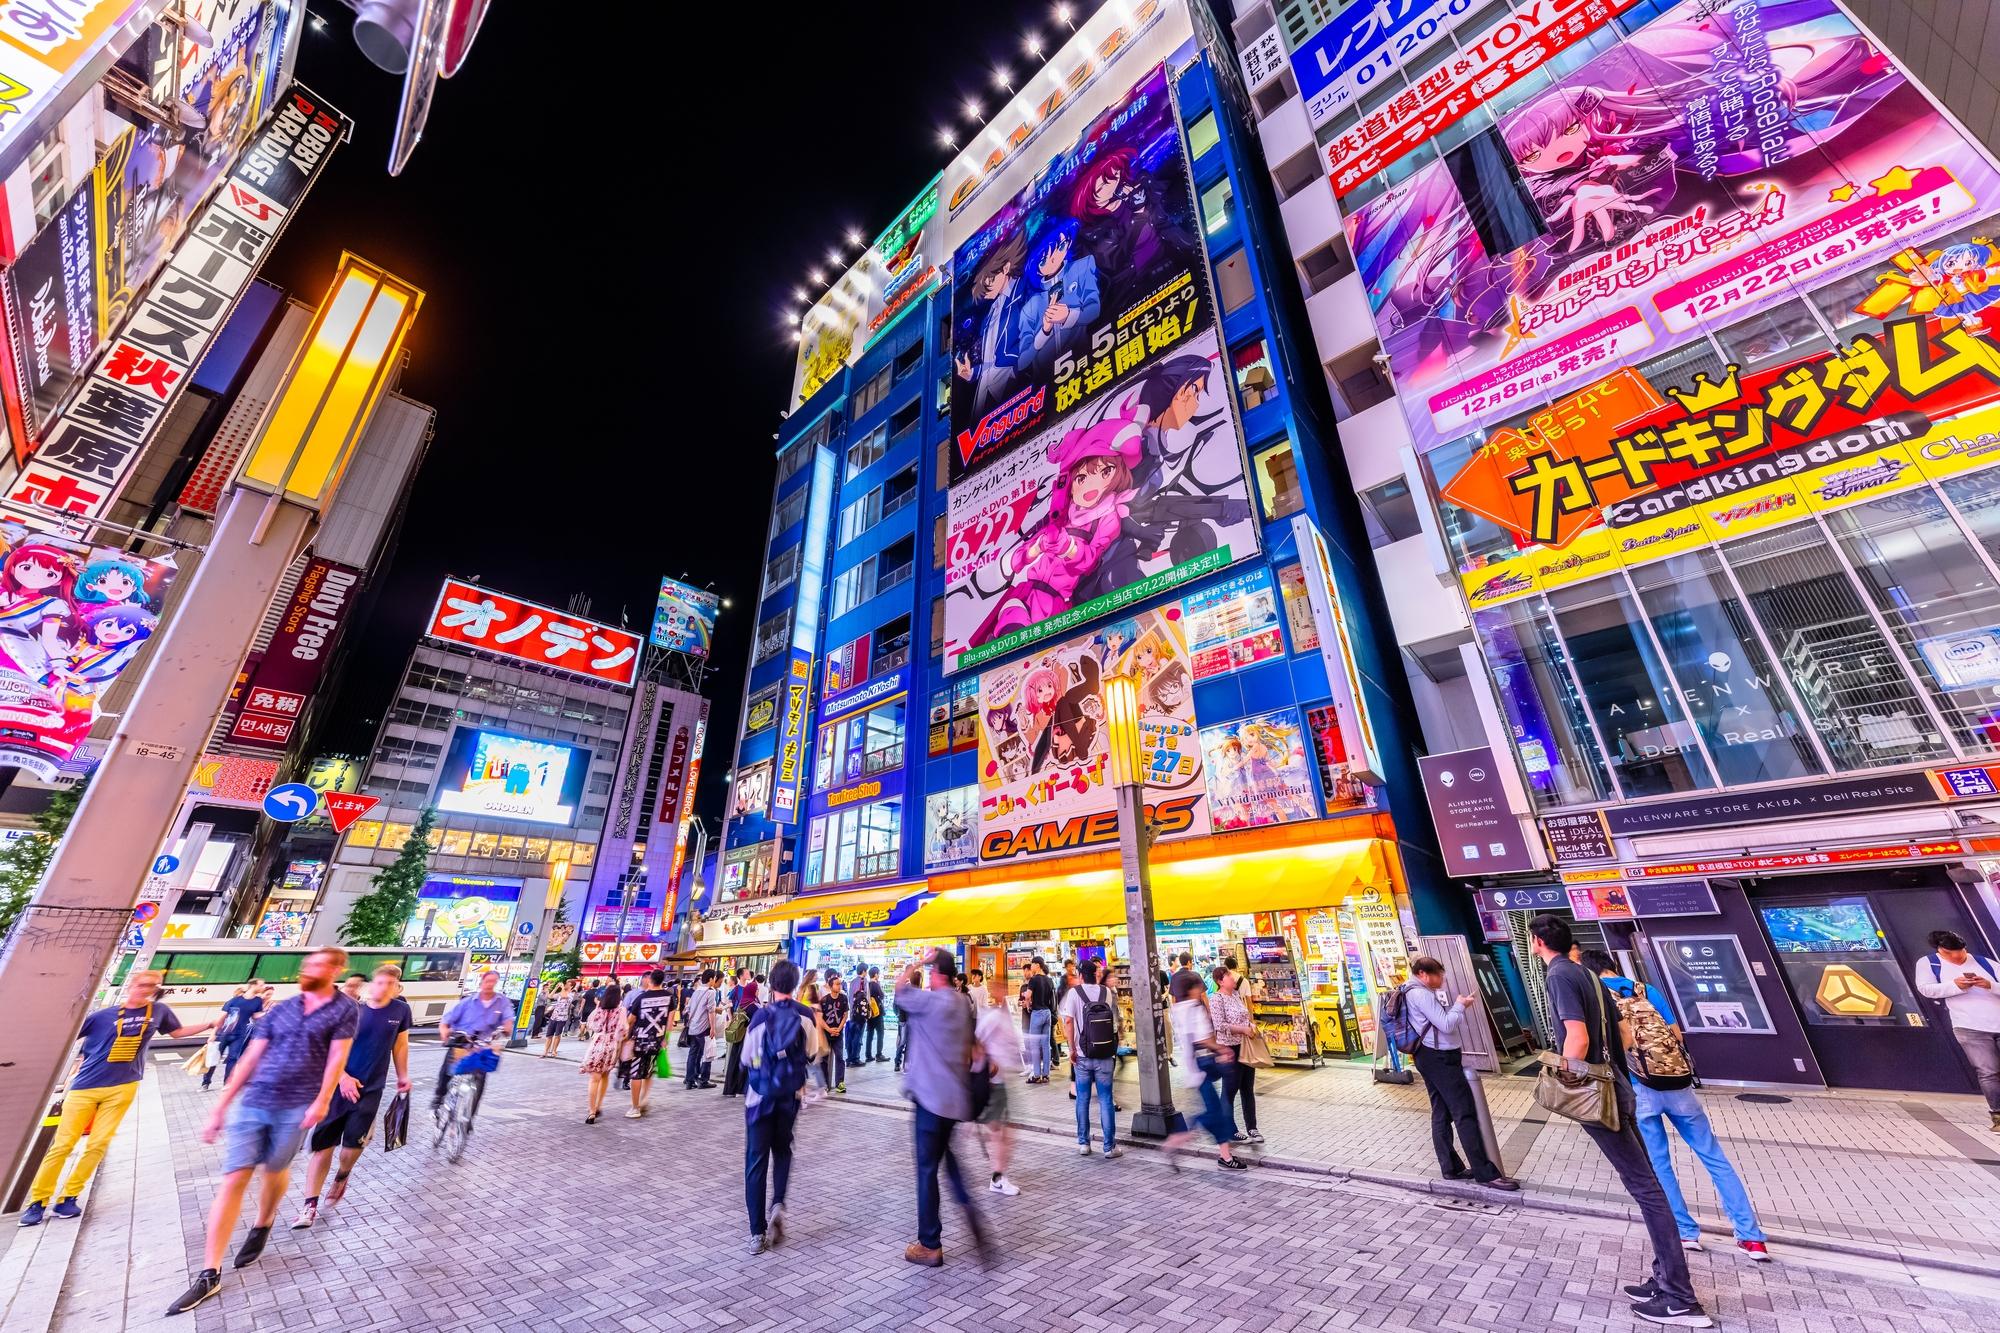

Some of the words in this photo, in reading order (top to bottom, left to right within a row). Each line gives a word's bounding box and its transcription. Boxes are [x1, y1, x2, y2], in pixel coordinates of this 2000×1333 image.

[1244, 47, 1265, 86] 野村ビル
[1260, 33, 1283, 73] 秋葉原
[1711, 41, 1750, 142] すべてを賭ける
[238, 90, 317, 187] PARADISE
[291, 108, 339, 177] HOBBY
[1338, 91, 1467, 189] ホビーランド
[1558, 256, 1612, 291] BanG
[1615, 204, 1707, 272] Dream!
[1683, 195, 1941, 320] 12月22日(金)発売!
[867, 264, 936, 330] TAKARADA
[1053, 284, 1196, 384] 5月5日(土)より
[11, 212, 265, 516] ボークス秋葉原ホ
[1054, 297, 1199, 413] 放送開始!
[1461, 337, 1618, 417] 12月8日(金)発売!
[1478, 380, 1619, 459] カードゲームで
[1513, 318, 2000, 542] カードキングダム
[1920, 431, 2000, 461] Cha
[952, 435, 1065, 508] ガンゲイル・オンライン
[1613, 420, 1912, 523] cardkingdom
[1010, 478, 1038, 502] 第1巻
[1822, 472, 1901, 501] Schwarz
[1620, 534, 1660, 552] Battle
[1661, 523, 1700, 540] Spirits
[970, 551, 997, 572] SALE
[297, 564, 326, 604] Flagship
[310, 568, 357, 616] Duty
[285, 605, 307, 633] Store
[440, 596, 636, 670] オノデン
[291, 614, 337, 661] Free
[963, 637, 1018, 665] Blu-ray&DVD
[1019, 628, 1043, 644] 第1巻
[793, 660, 809, 679] 薬
[1609, 653, 1884, 717] ALIENWARE
[252, 692, 299, 712] 免税
[699, 701, 709, 727] ADULT
[239, 718, 290, 737] 면세점
[694, 726, 705, 755] GOODS
[780, 685, 807, 783] マツモトキヨシ
[1643, 742, 1691, 759] Dell
[1723, 724, 1785, 746] Real
[1813, 711, 1875, 732] Site
[136, 747, 176, 760] 18-45
[689, 766, 699, 788] LOVE
[982, 753, 1109, 823] こみっくがーるず
[1951, 769, 1981, 780] カード
[1954, 777, 1988, 788] ゲーム
[683, 788, 695, 816] MERCI
[858, 781, 882, 800] Shop
[1447, 796, 1494, 808] ALIENWARE
[1623, 808, 1700, 824] ALIENWARE
[1704, 803, 1751, 815] STORE
[1756, 797, 1802, 810] AKIBA
[1823, 792, 1849, 803] Dell
[1851, 788, 1882, 799] Real
[1884, 785, 1914, 796] Site
[331, 800, 366, 812] 止まれ
[482, 800, 536, 817] ONODEN
[1449, 807, 1472, 816] STORE
[1473, 804, 1496, 813] AKIBA
[1469, 820, 1483, 828] Real
[1484, 818, 1498, 826] Site
[1547, 815, 1599, 829] お部屋探し
[1569, 827, 1602, 837] iDEAL
[1571, 832, 1604, 840] アイデアル
[1555, 842, 1594, 853] 当ビル8F
[1558, 850, 1597, 860] 入口はこちら
[1757, 856, 1804, 867] ホビーランド
[1838, 847, 1910, 860] エレベーターはこちら
[452, 876, 484, 887] Welcome
[485, 879, 495, 887] to
[1565, 871, 1607, 882] エレベーター
